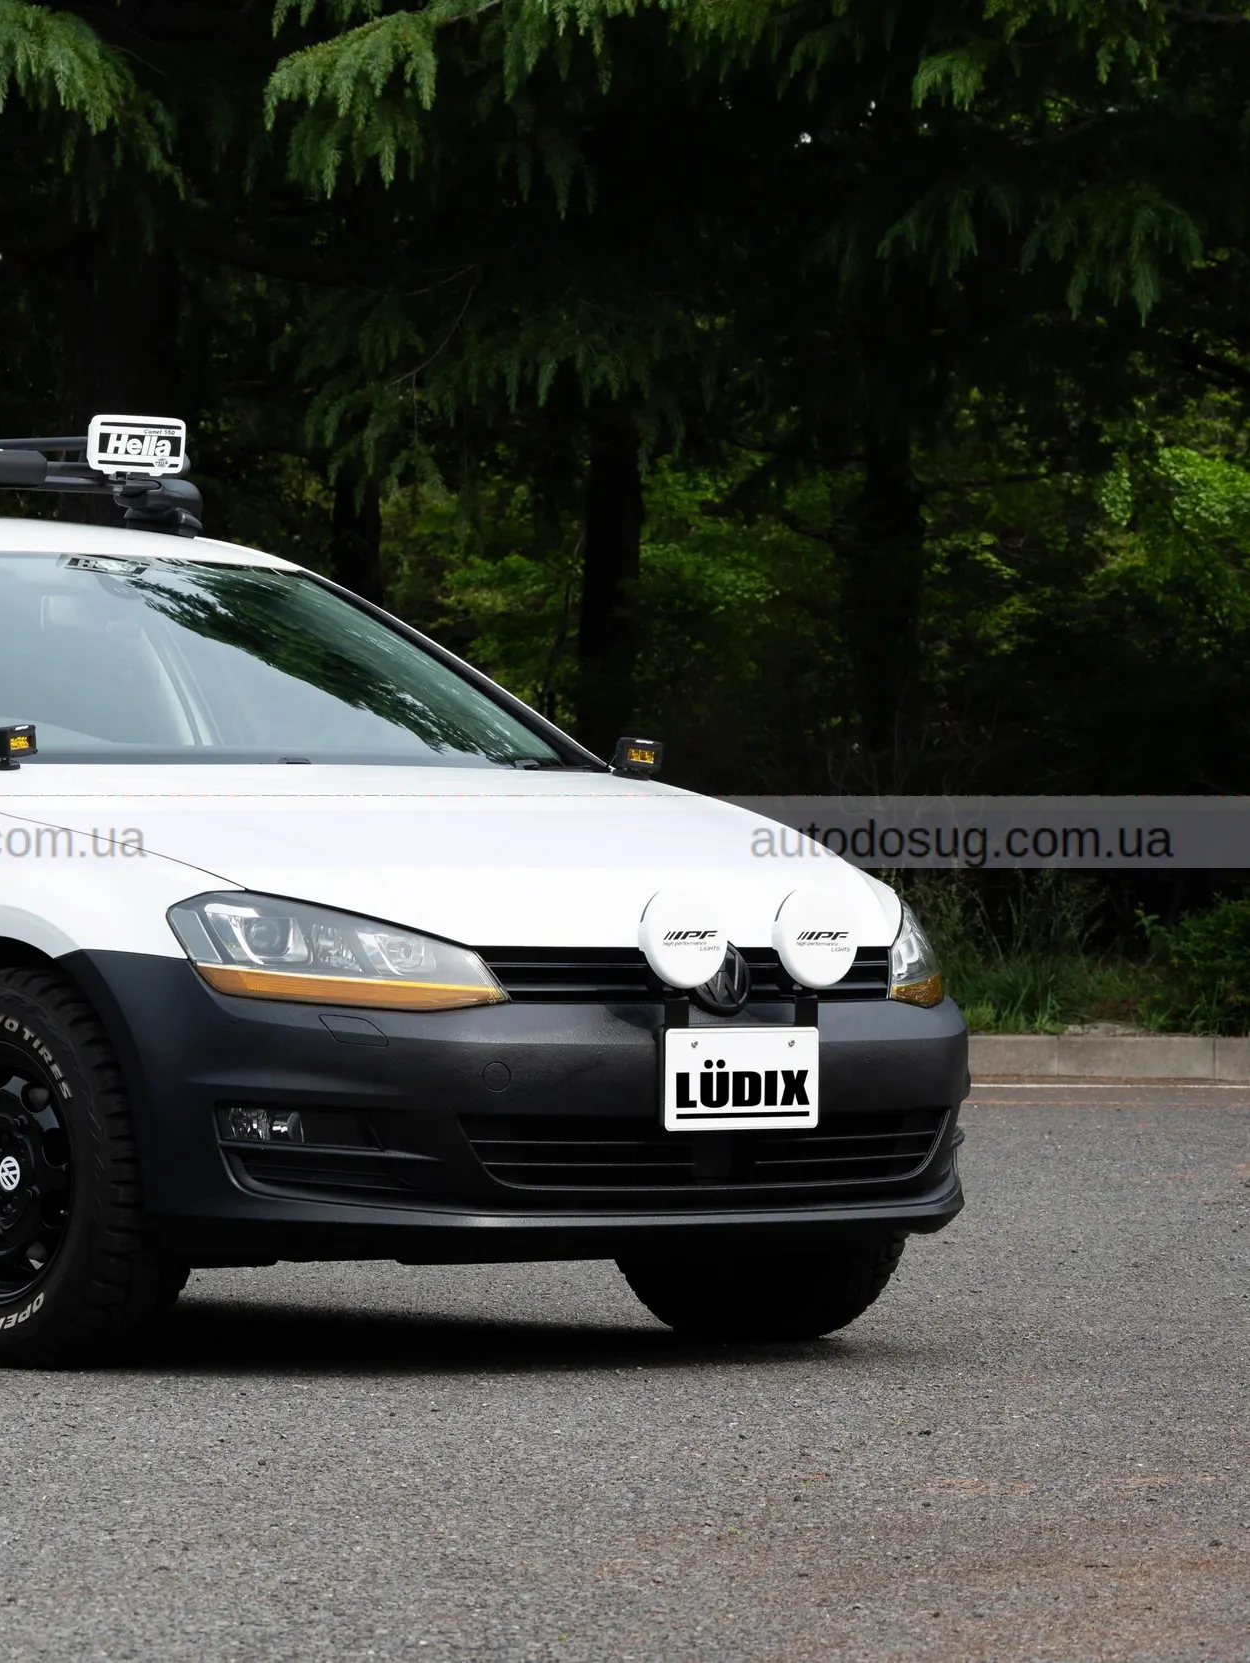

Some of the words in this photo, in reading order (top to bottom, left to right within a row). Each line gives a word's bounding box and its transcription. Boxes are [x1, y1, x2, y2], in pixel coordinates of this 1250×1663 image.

[106, 433, 172, 457] Hella
[22, 1026, 74, 1101] TIRES
[675, 1059, 810, 1109] LÜDIX
